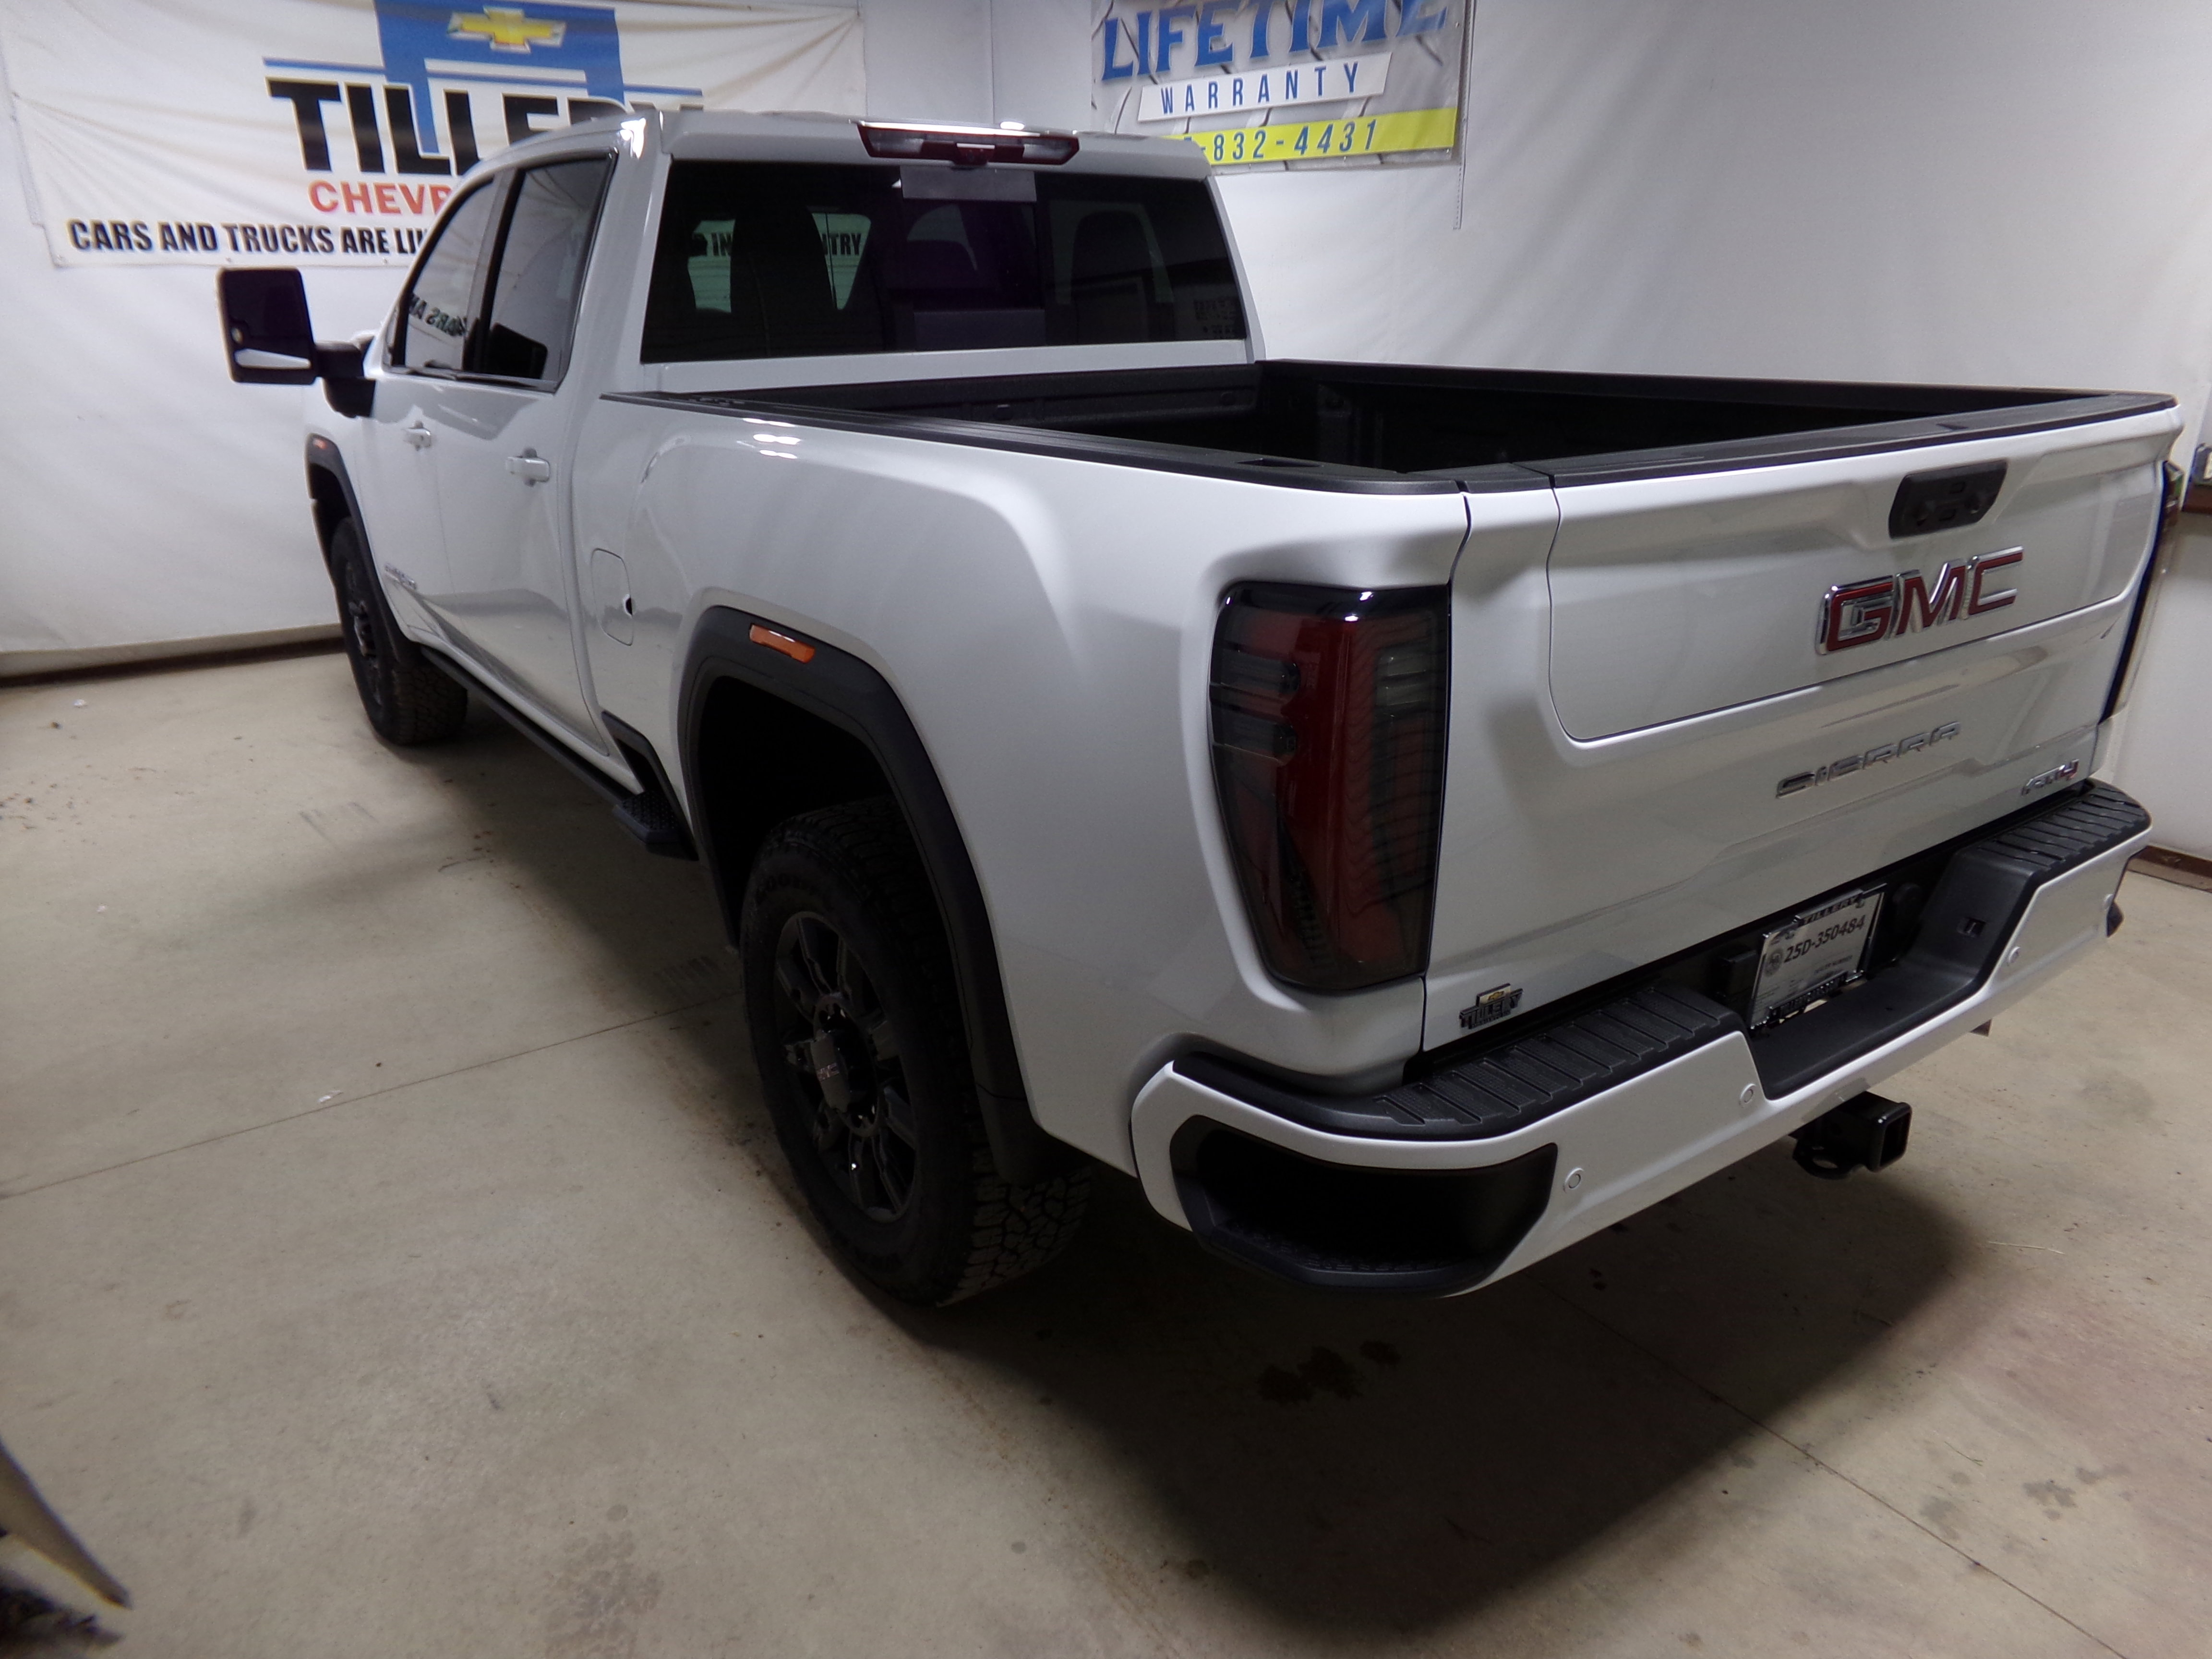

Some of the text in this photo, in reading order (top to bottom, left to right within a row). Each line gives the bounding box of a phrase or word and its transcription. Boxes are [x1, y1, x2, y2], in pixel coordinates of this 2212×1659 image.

[1101, 0, 1447, 81] LIFETIME
[1160, 61, 1359, 115] WARRANTY
[1184, 119, 1377, 162] -832-4431
[68, 218, 152, 253] CARS
[157, 221, 217, 252] AND
[221, 222, 335, 254] TRUCKS
[340, 226, 390, 254] ARE
[1815, 544, 2024, 656] GMC
[1783, 914, 1866, 964] 25D-350484
